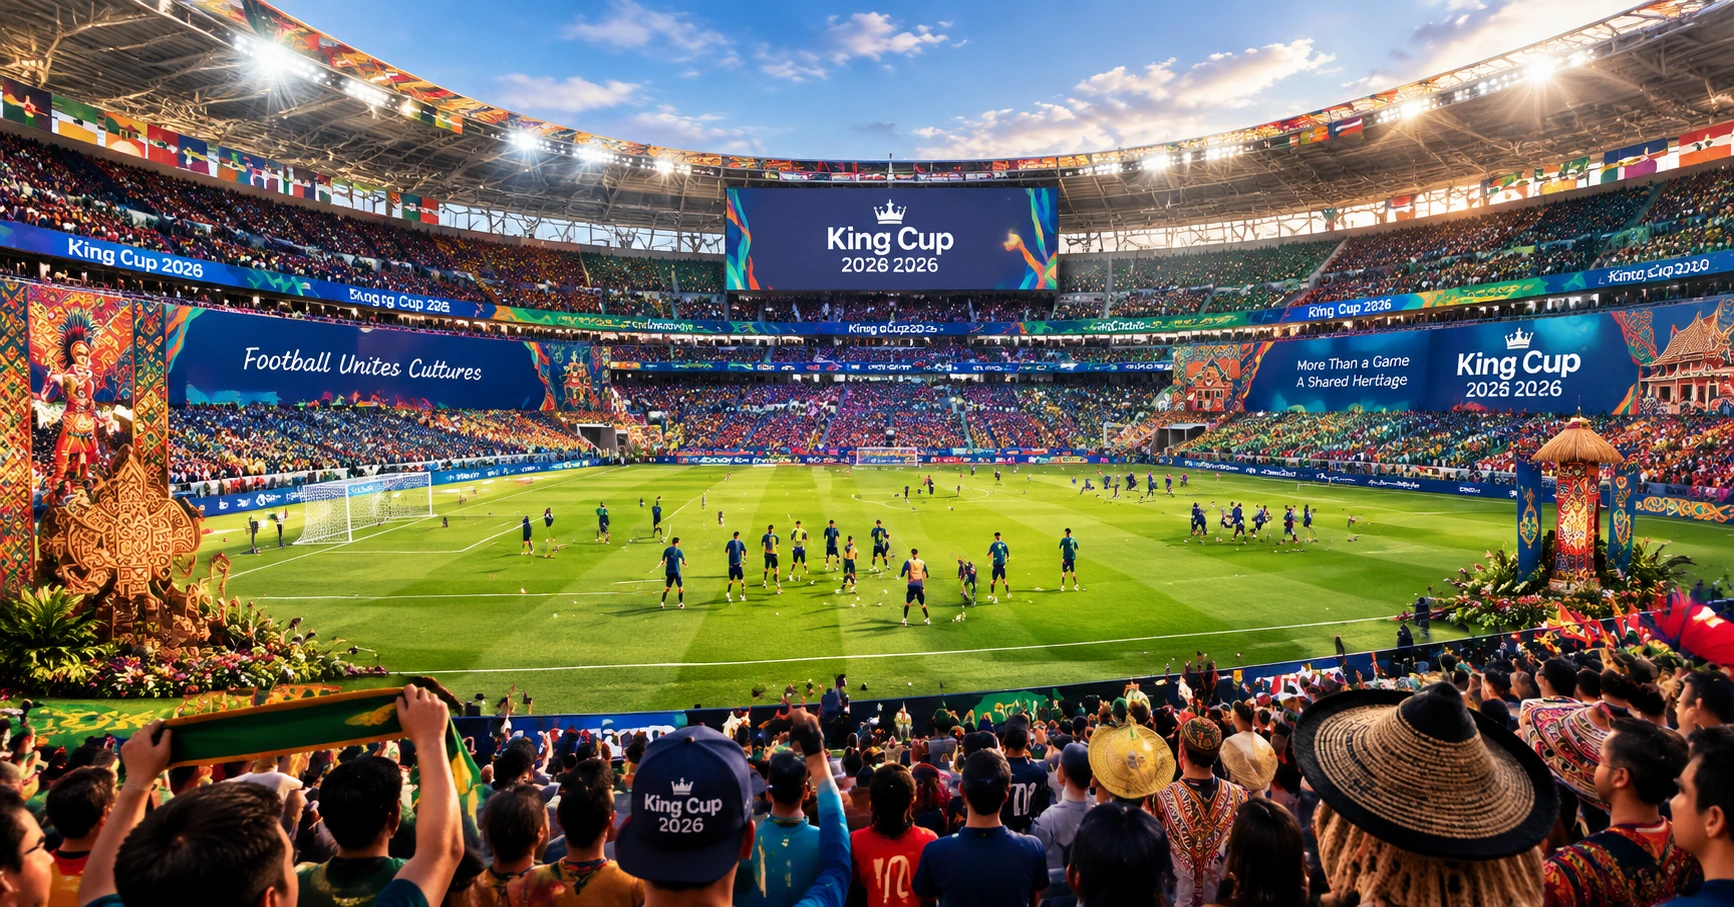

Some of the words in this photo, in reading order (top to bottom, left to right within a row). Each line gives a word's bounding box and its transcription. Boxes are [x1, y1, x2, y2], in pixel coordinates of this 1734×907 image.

[827, 225, 891, 256] King
[897, 226, 955, 256] Cup
[68, 237, 116, 266] King
[120, 249, 158, 272] Cup
[161, 257, 204, 278] 2026
[893, 257, 939, 273] 2026
[399, 295, 424, 312] Cup
[1338, 303, 1361, 317] Cup
[243, 346, 331, 374] Football
[339, 353, 402, 377] Unites
[1297, 359, 1326, 371] More
[1328, 357, 1358, 370] Than
[1361, 359, 1369, 369] a
[1372, 355, 1410, 368] Game
[1456, 351, 1518, 381] King
[1522, 350, 1582, 378] Cup
[1296, 376, 1305, 388] A
[1307, 375, 1350, 388] Shared
[1513, 380, 1563, 397] 2026
[644, 793, 683, 818] King
[686, 797, 723, 816] Cup
[658, 817, 704, 833] 2026
